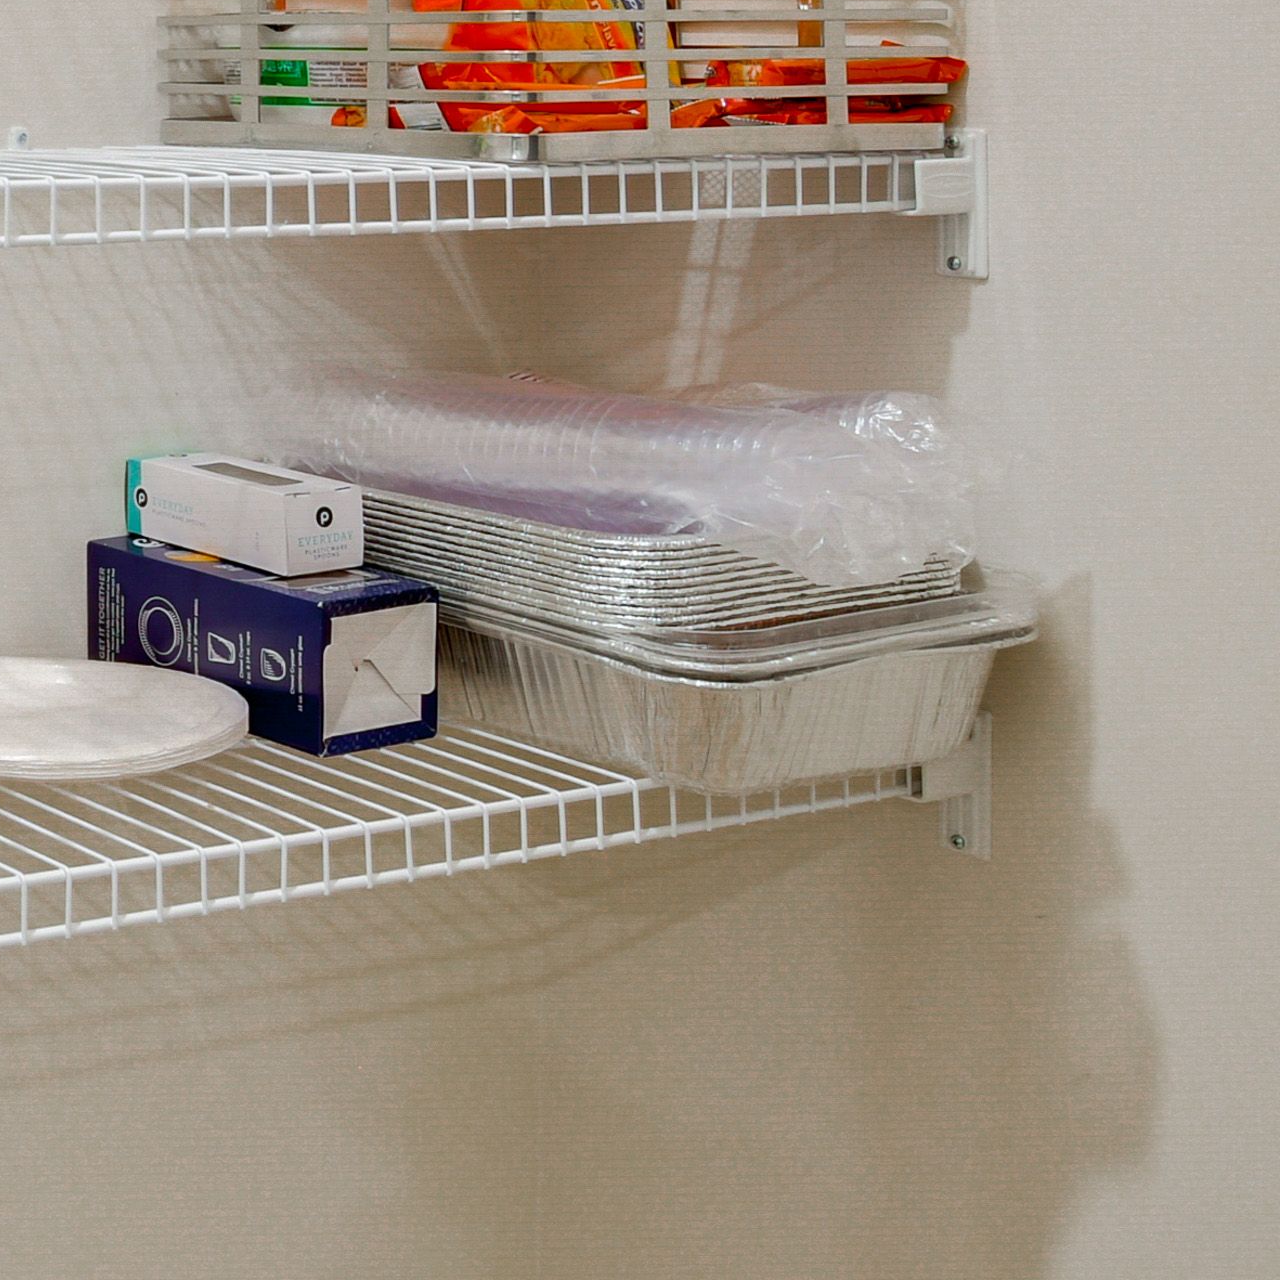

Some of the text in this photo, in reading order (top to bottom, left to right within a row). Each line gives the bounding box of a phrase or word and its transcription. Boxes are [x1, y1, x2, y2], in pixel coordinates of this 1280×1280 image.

[152, 496, 194, 514] EVERYDAY
[297, 530, 354, 547] EVERYDAY
[304, 544, 348, 555] PLASTICWARE
[313, 552, 340, 561] SPOONS
[99, 626, 105, 636] IT
